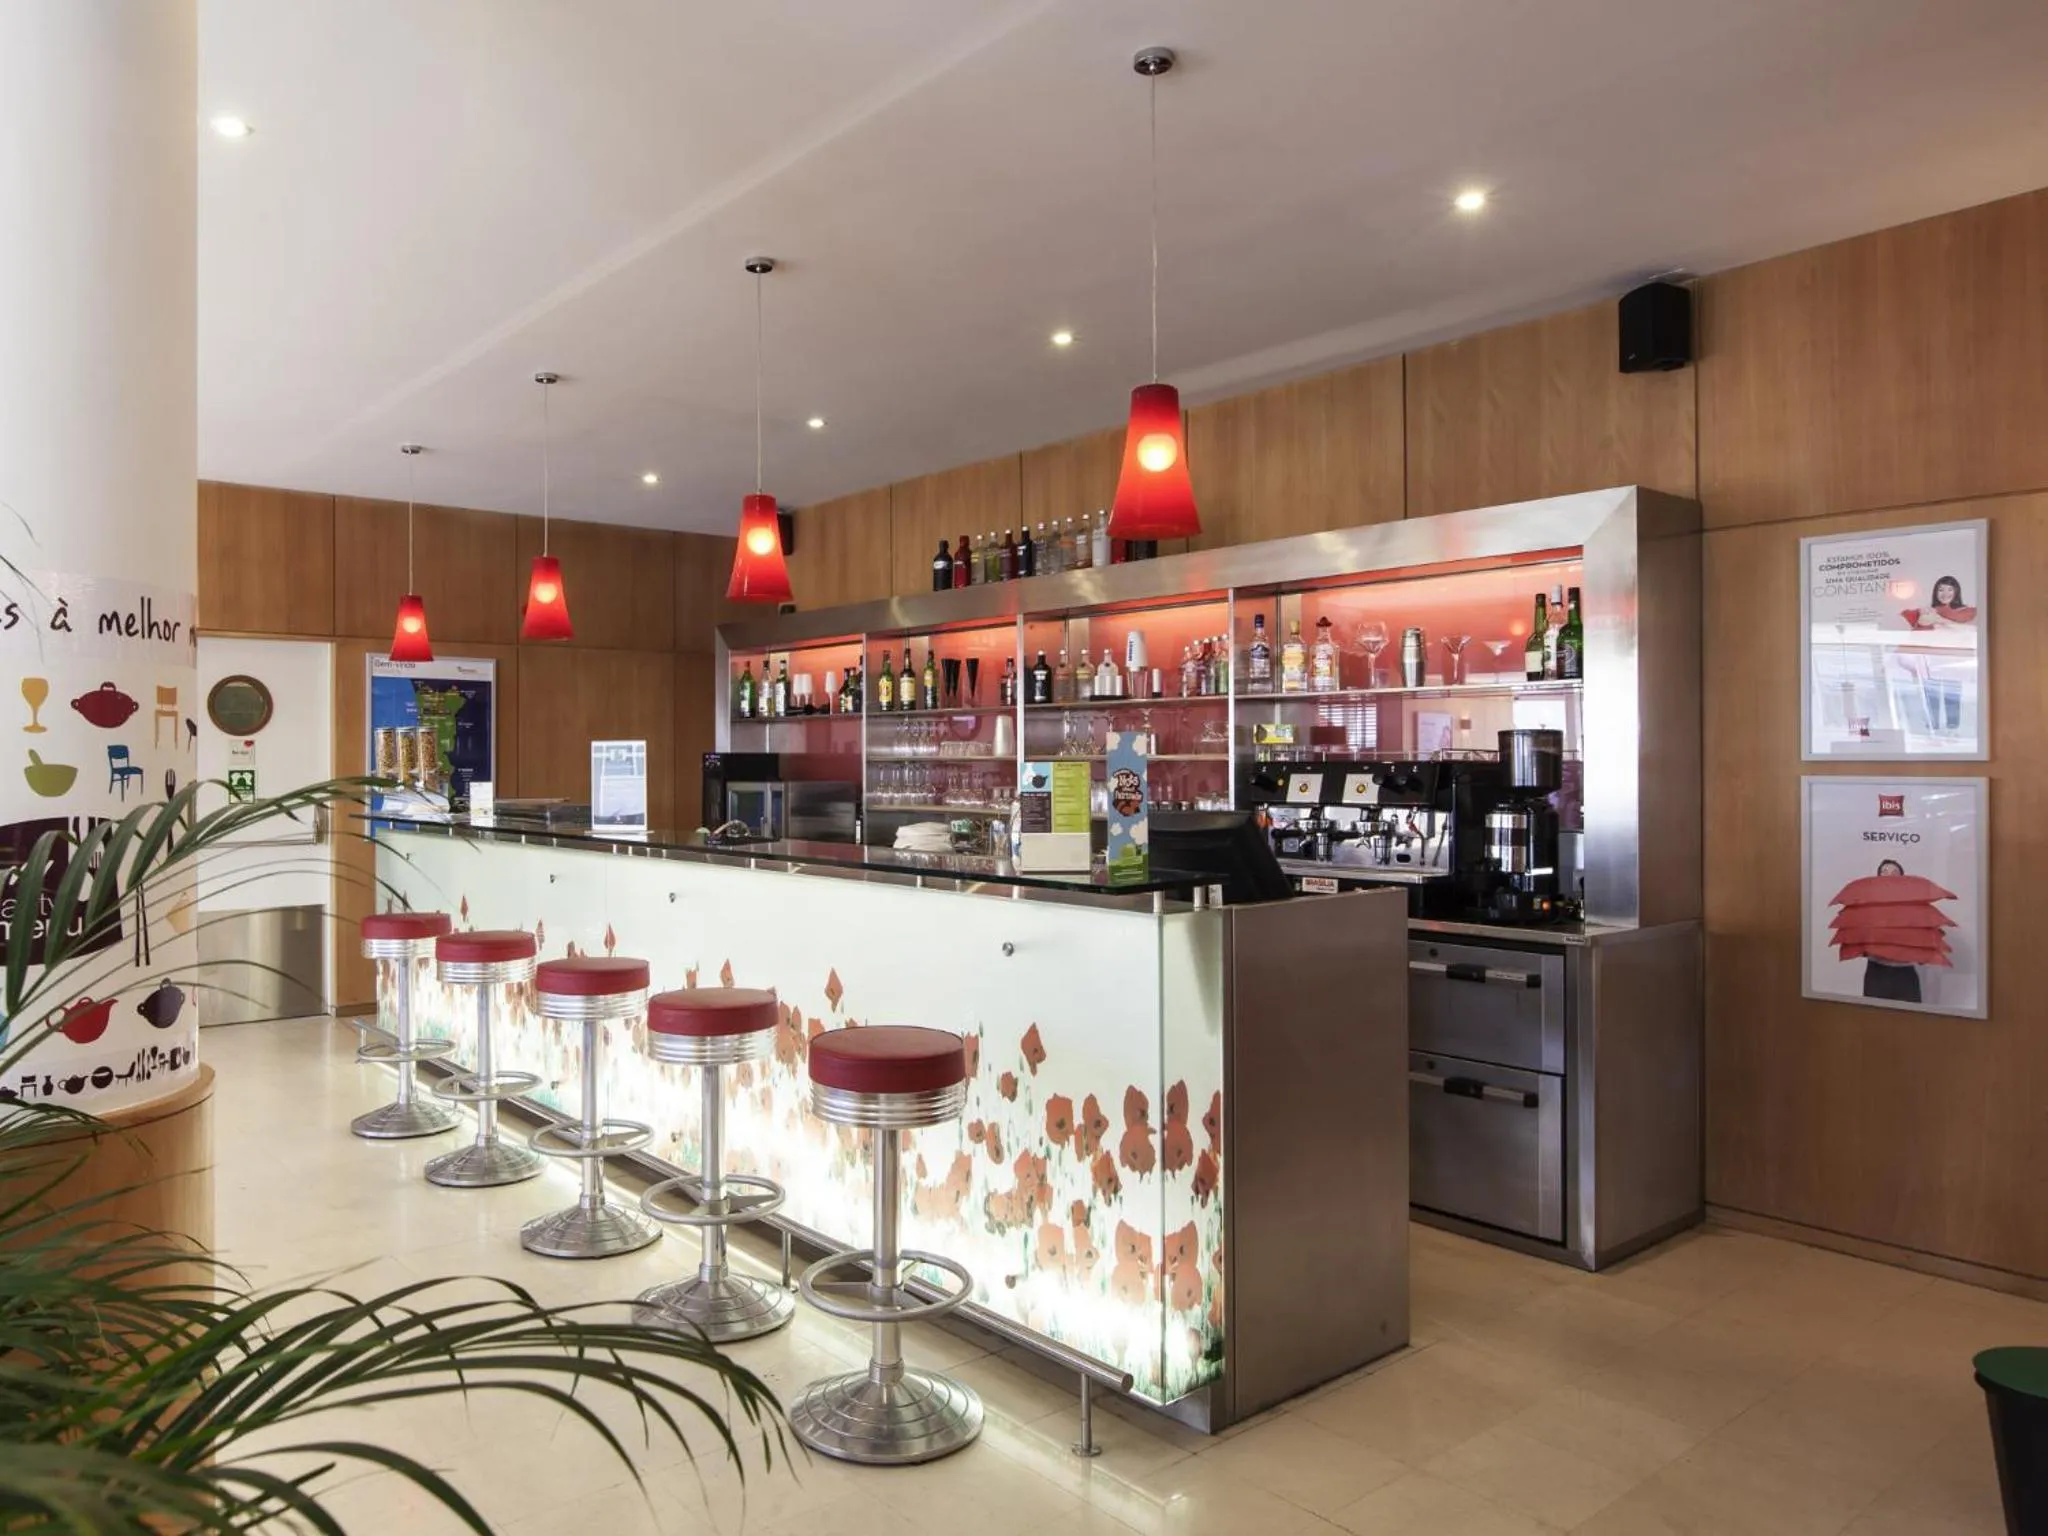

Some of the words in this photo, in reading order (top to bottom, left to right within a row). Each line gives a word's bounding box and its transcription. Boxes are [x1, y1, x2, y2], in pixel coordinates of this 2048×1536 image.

[1818, 558, 1901, 571] COMPROMETIDOS
[1845, 573, 1890, 583] QUALIDADE
[51, 597, 73, 633] à
[99, 596, 181, 643] melhor
[1862, 831, 1921, 844] SERVIÇO
